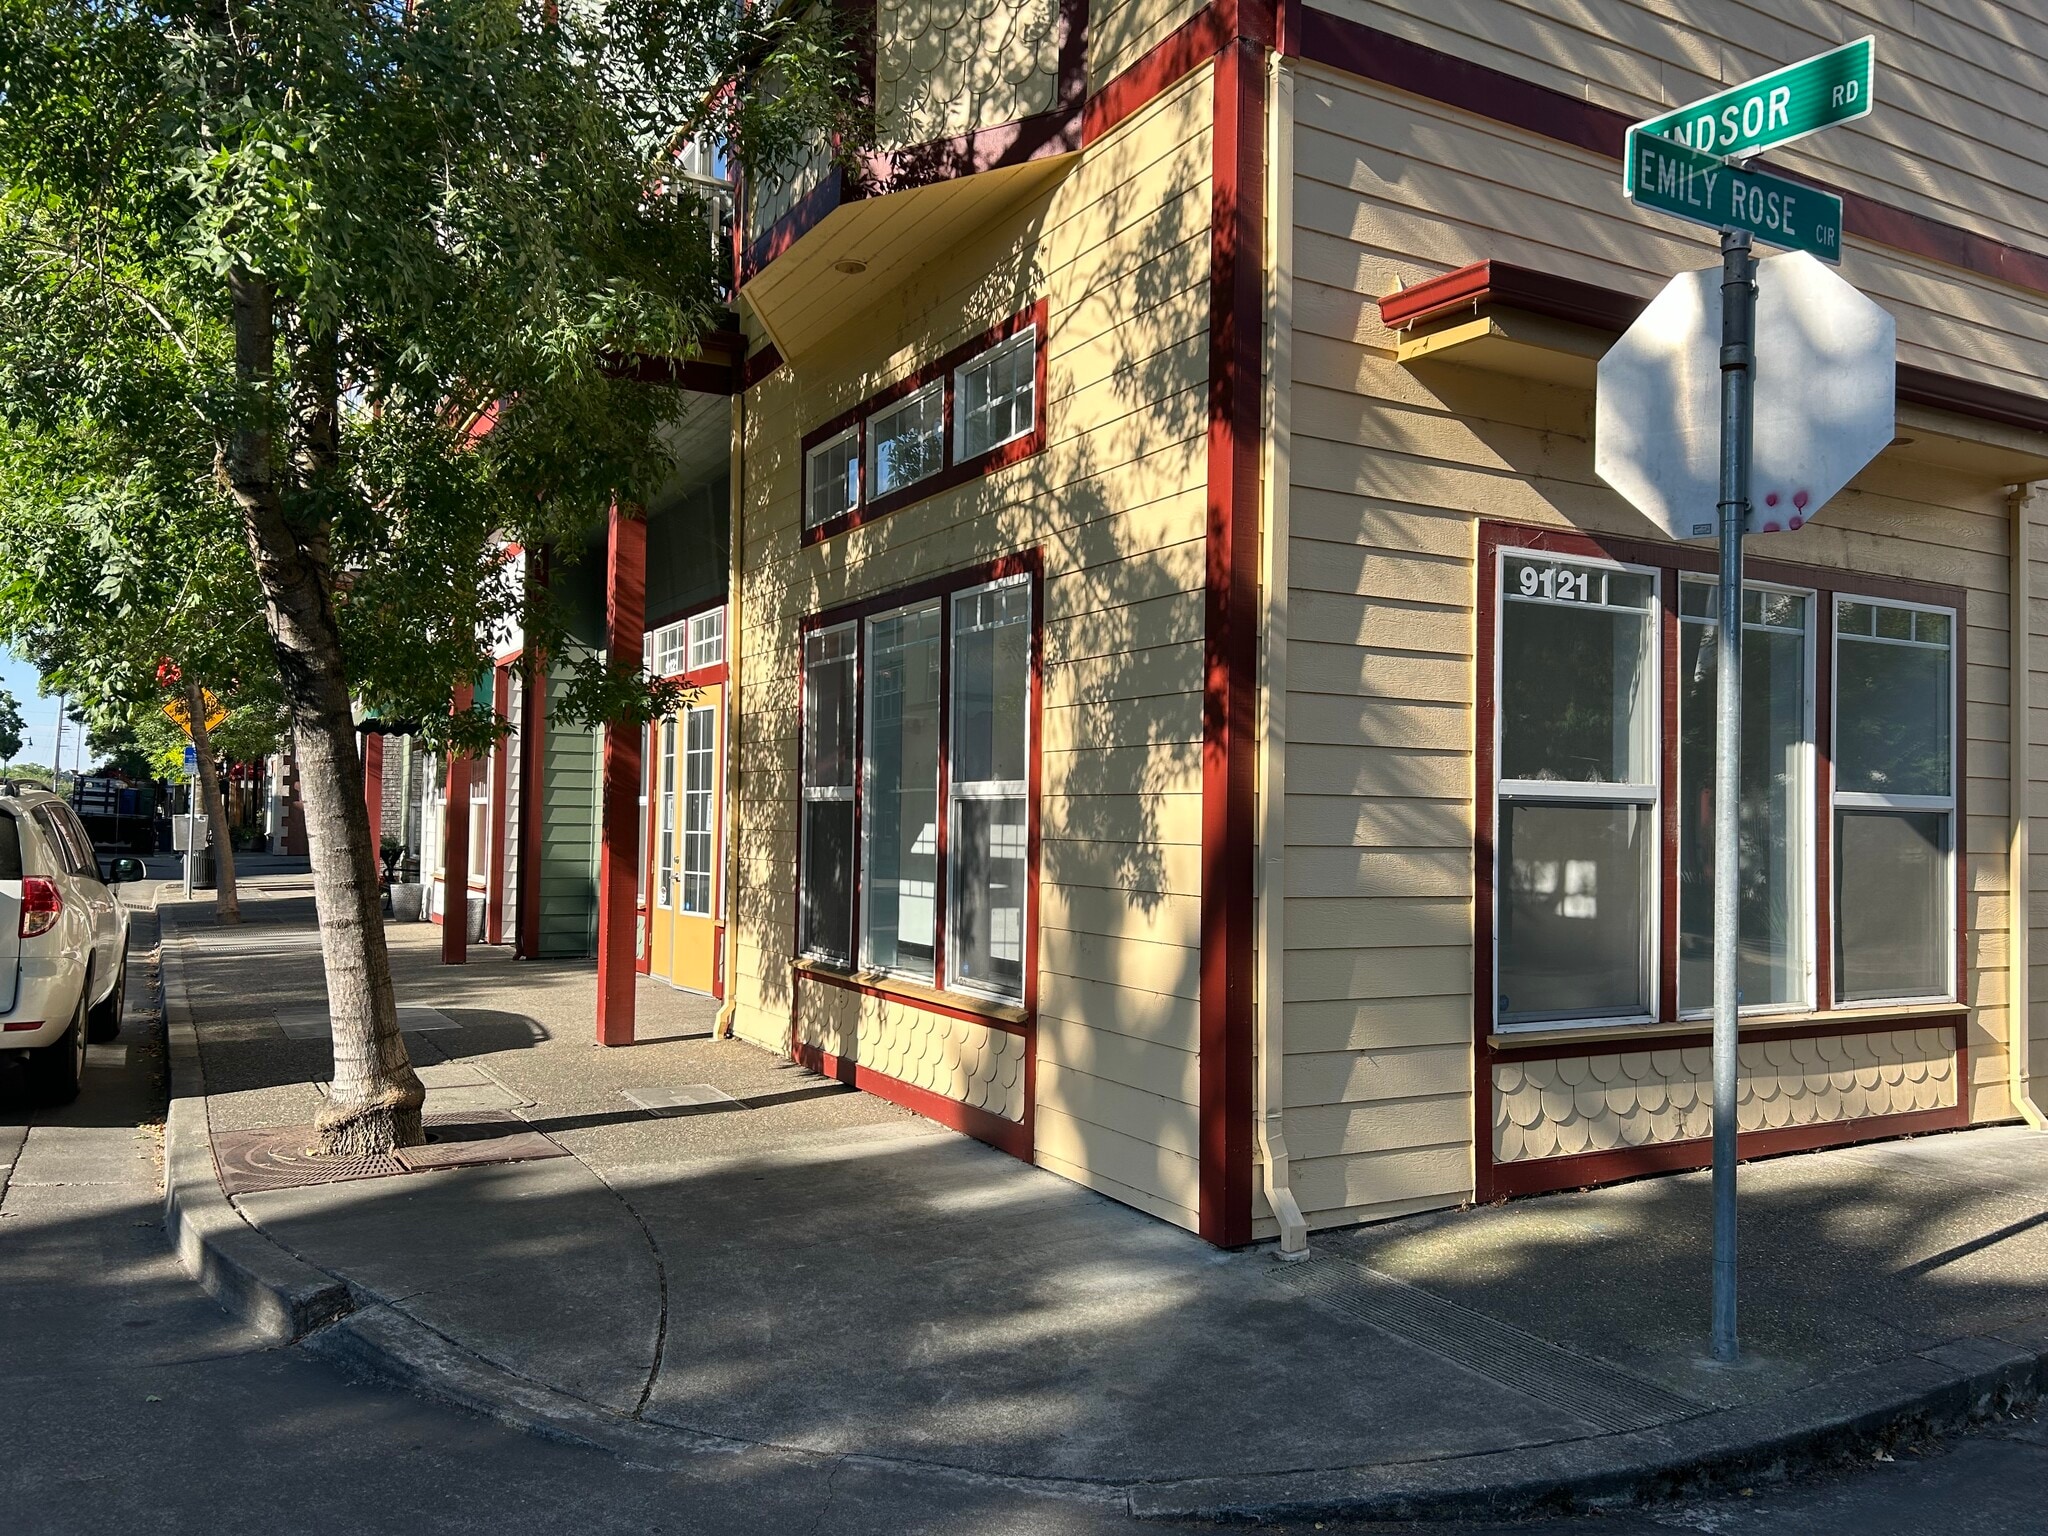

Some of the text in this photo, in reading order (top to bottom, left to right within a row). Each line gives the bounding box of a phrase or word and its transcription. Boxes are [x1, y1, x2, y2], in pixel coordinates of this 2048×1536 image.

[1657, 79, 1859, 154] NDSOR RD
[1640, 148, 1835, 247] EMILY ROSE CIR
[1519, 566, 1588, 601] 9121
